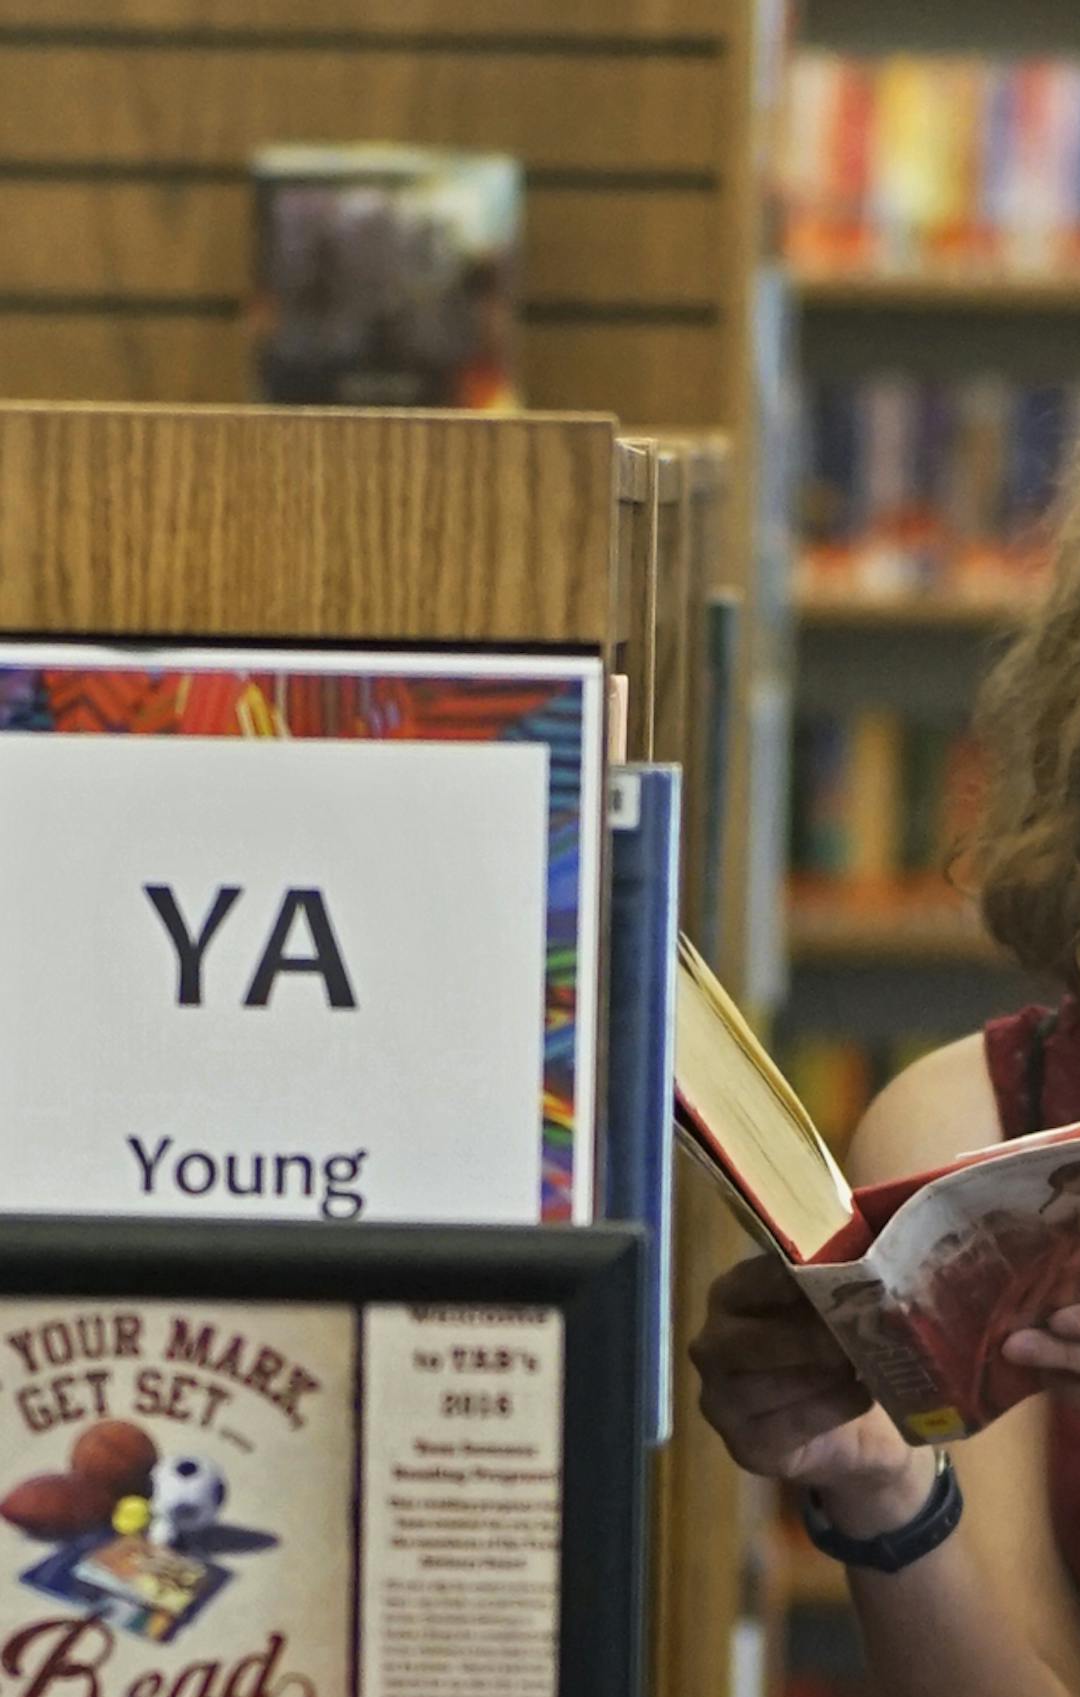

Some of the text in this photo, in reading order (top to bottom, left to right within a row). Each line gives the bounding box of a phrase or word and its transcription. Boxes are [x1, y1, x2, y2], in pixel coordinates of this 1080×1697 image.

[143, 884, 358, 1009] YA
[126, 1135, 369, 1221] Young
[8, 1314, 142, 1373] YOUR
[17, 1370, 109, 1433] GET
